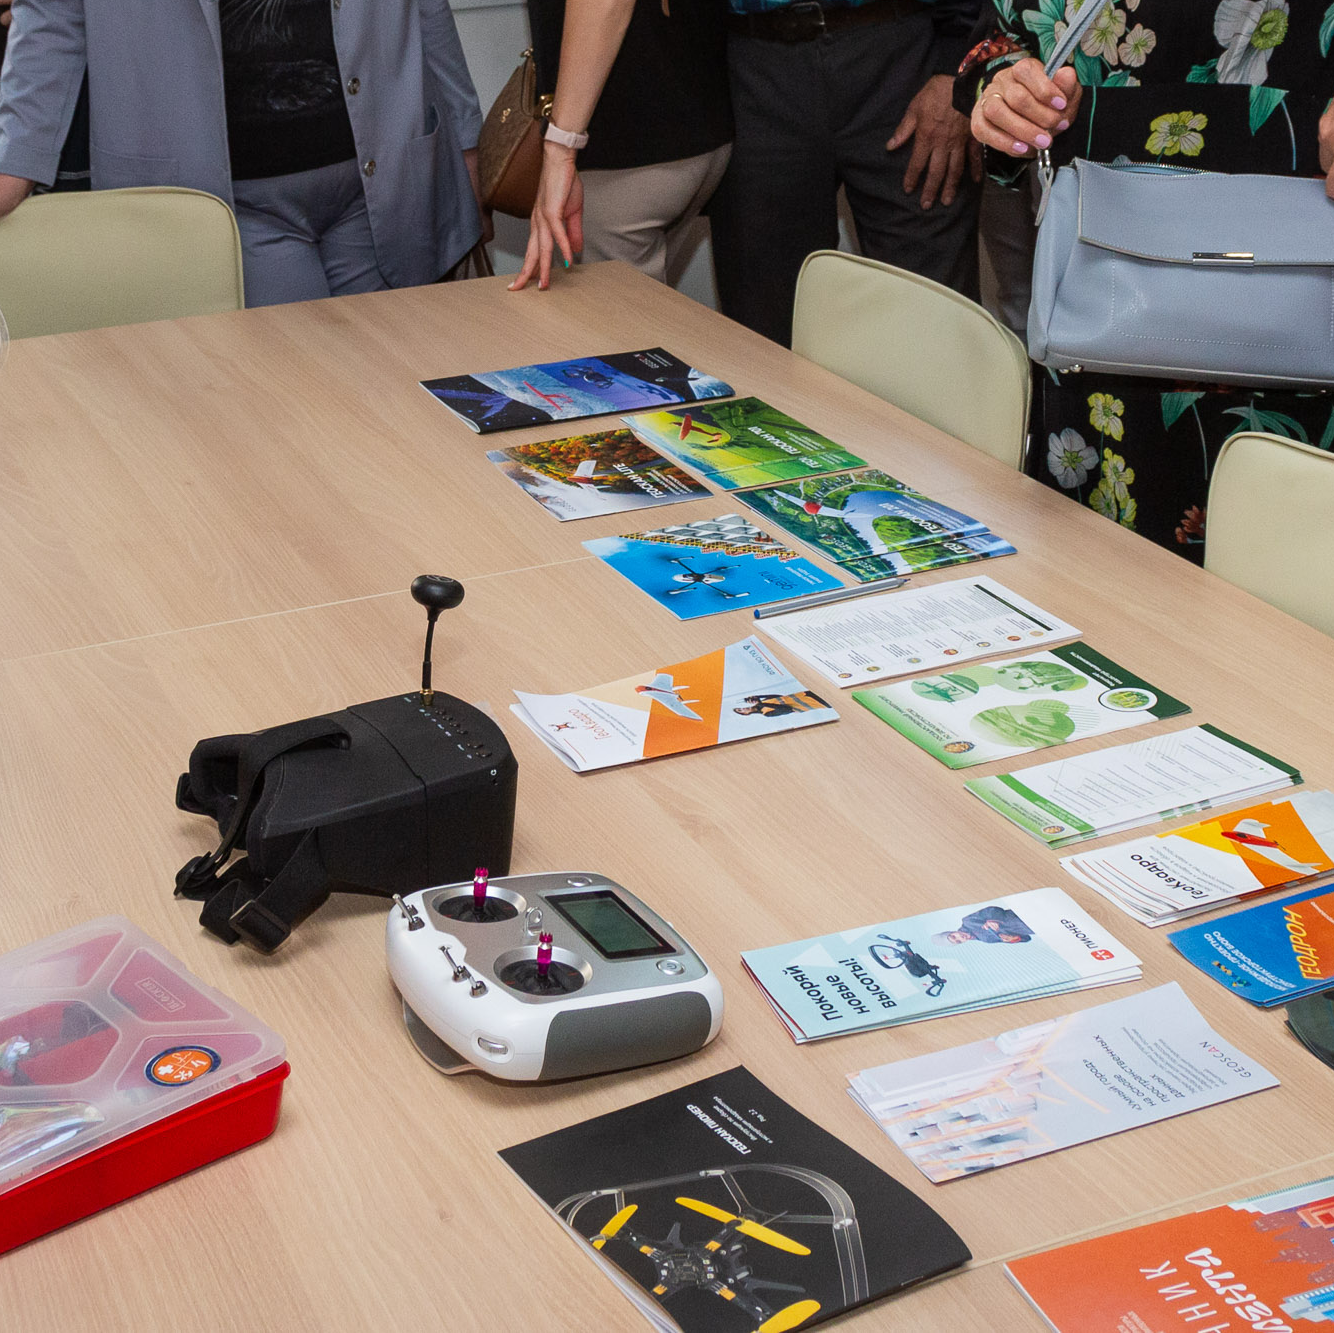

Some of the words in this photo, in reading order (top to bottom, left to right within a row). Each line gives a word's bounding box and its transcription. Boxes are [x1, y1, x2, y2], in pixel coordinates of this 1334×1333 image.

[758, 433, 802, 454] ГЕОСКАН
[611, 462, 635, 474] LITE
[626, 474, 668, 498] ГЕОСКАН
[892, 509, 945, 533] ГЕОСКАН
[568, 707, 611, 740] ГеоКвадро
[1129, 853, 1209, 899] ГеоКвадро
[1057, 917, 1100, 949] ПИОНЕР
[1210, 930, 1235, 949] БЮРО
[1282, 906, 1323, 979] ГЕОДРОН
[781, 964, 843, 1021] Покоряй
[823, 974, 870, 1015] новые
[837, 957, 897, 1009] высоты!
[1079, 1058, 1114, 1085] город»
[1092, 1034, 1172, 1102] пространственных
[1198, 1040, 1253, 1078] GEOSCAN
[1106, 1085, 1143, 1111] «Умный
[1112, 1073, 1145, 1097] основе
[1148, 1073, 1186, 1098] данных
[1140, 1097, 1156, 1106] на
[685, 1103, 719, 1128] ПИОНЕР
[713, 1127, 752, 1154] ГЕОСКАН
